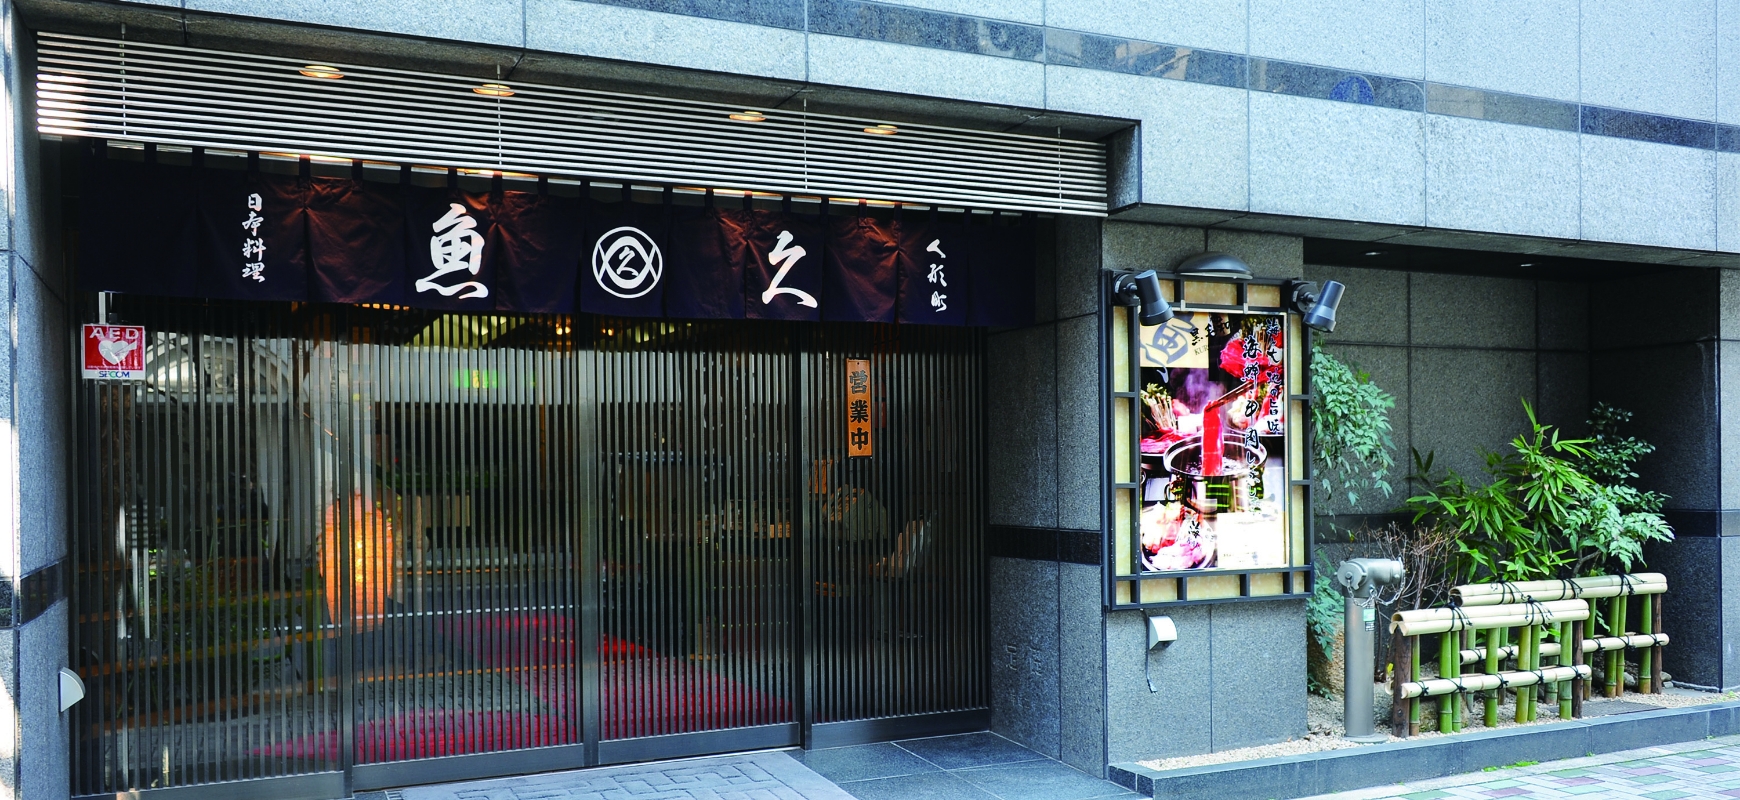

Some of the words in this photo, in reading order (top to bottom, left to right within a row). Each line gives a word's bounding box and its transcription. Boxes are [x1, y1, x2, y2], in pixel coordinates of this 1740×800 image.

[241, 192, 267, 283] 日本料理
[415, 202, 489, 300] 魚
[762, 230, 818, 309] 久
[926, 238, 948, 313] 人形町
[89, 327, 139, 339] AED
[849, 369, 869, 451] 営業中
